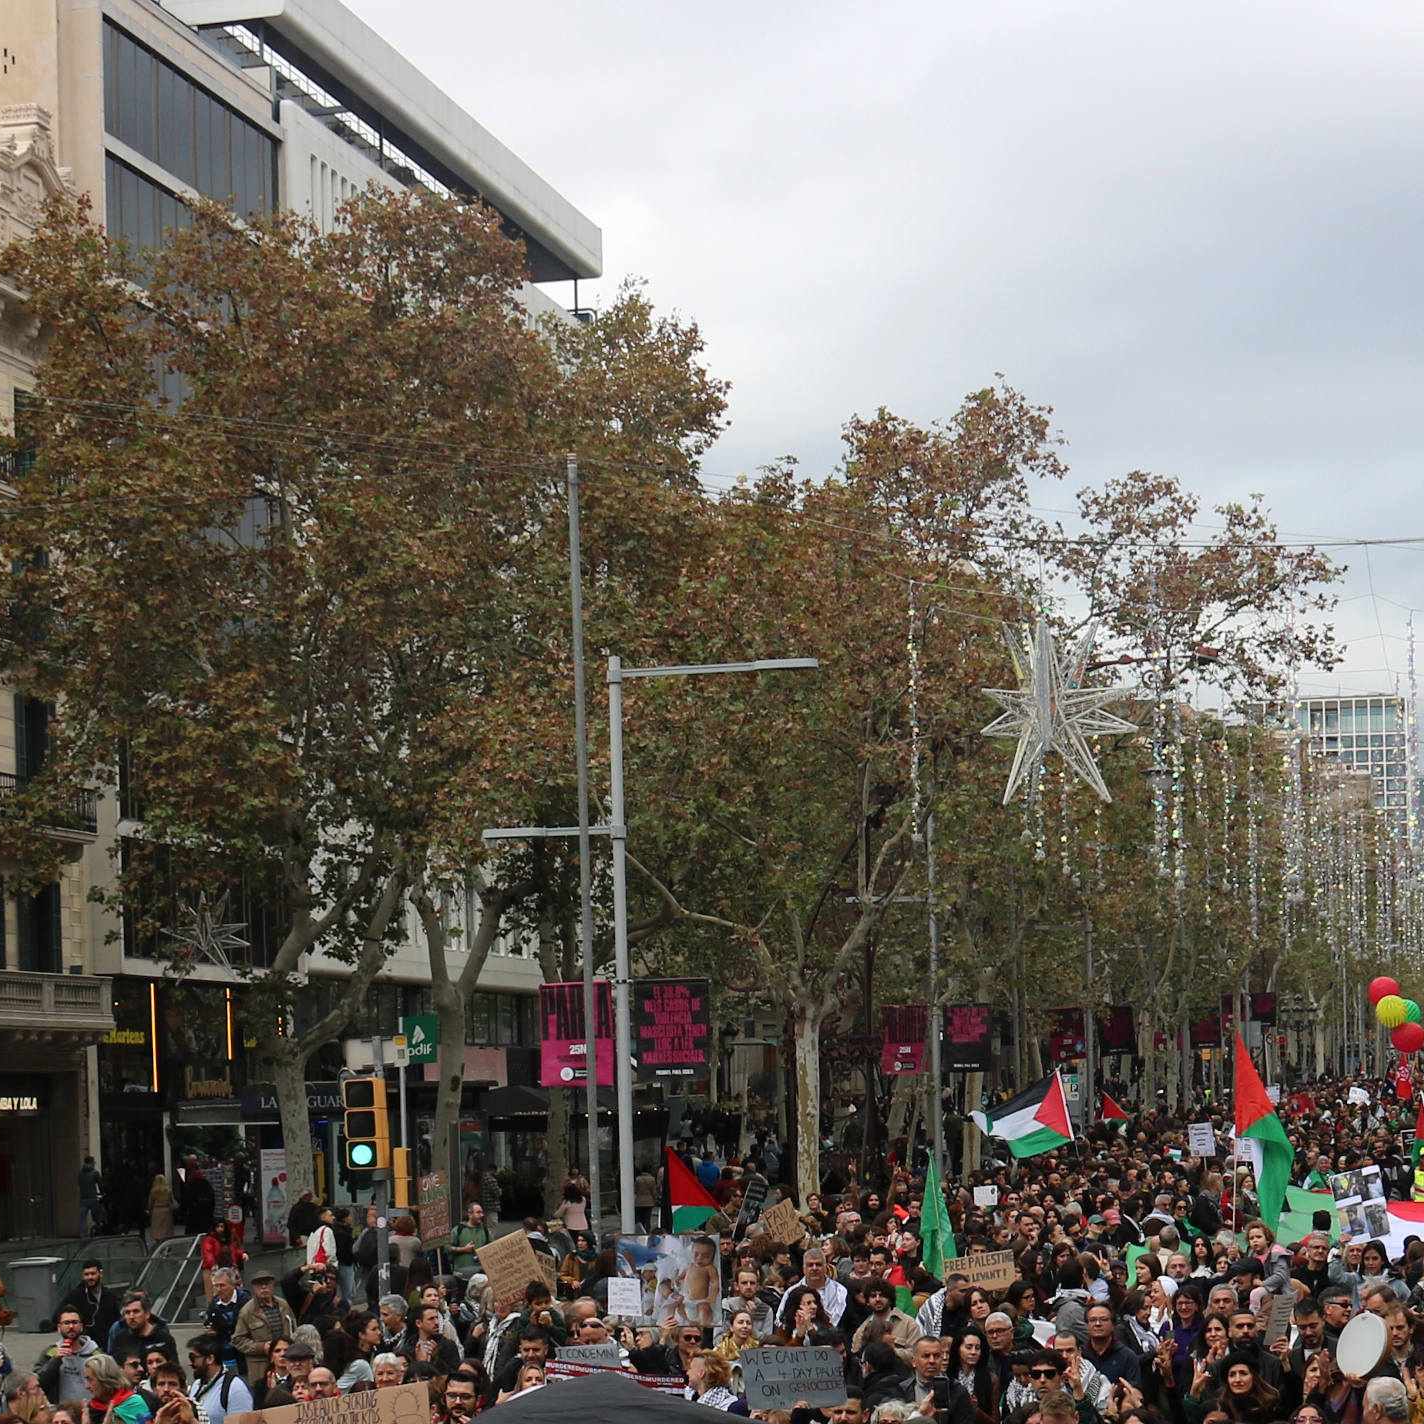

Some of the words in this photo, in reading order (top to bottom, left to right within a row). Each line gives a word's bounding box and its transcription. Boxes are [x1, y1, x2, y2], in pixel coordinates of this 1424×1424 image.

[19, 1097, 38, 1110] LOLA
[943, 1258, 967, 1272] FREE
[968, 1250, 1014, 1269] PALESTINE
[744, 1351, 772, 1366] WE
[814, 1349, 830, 1362] DO
[754, 1371, 765, 1382] A
[761, 1381, 782, 1398] ON
